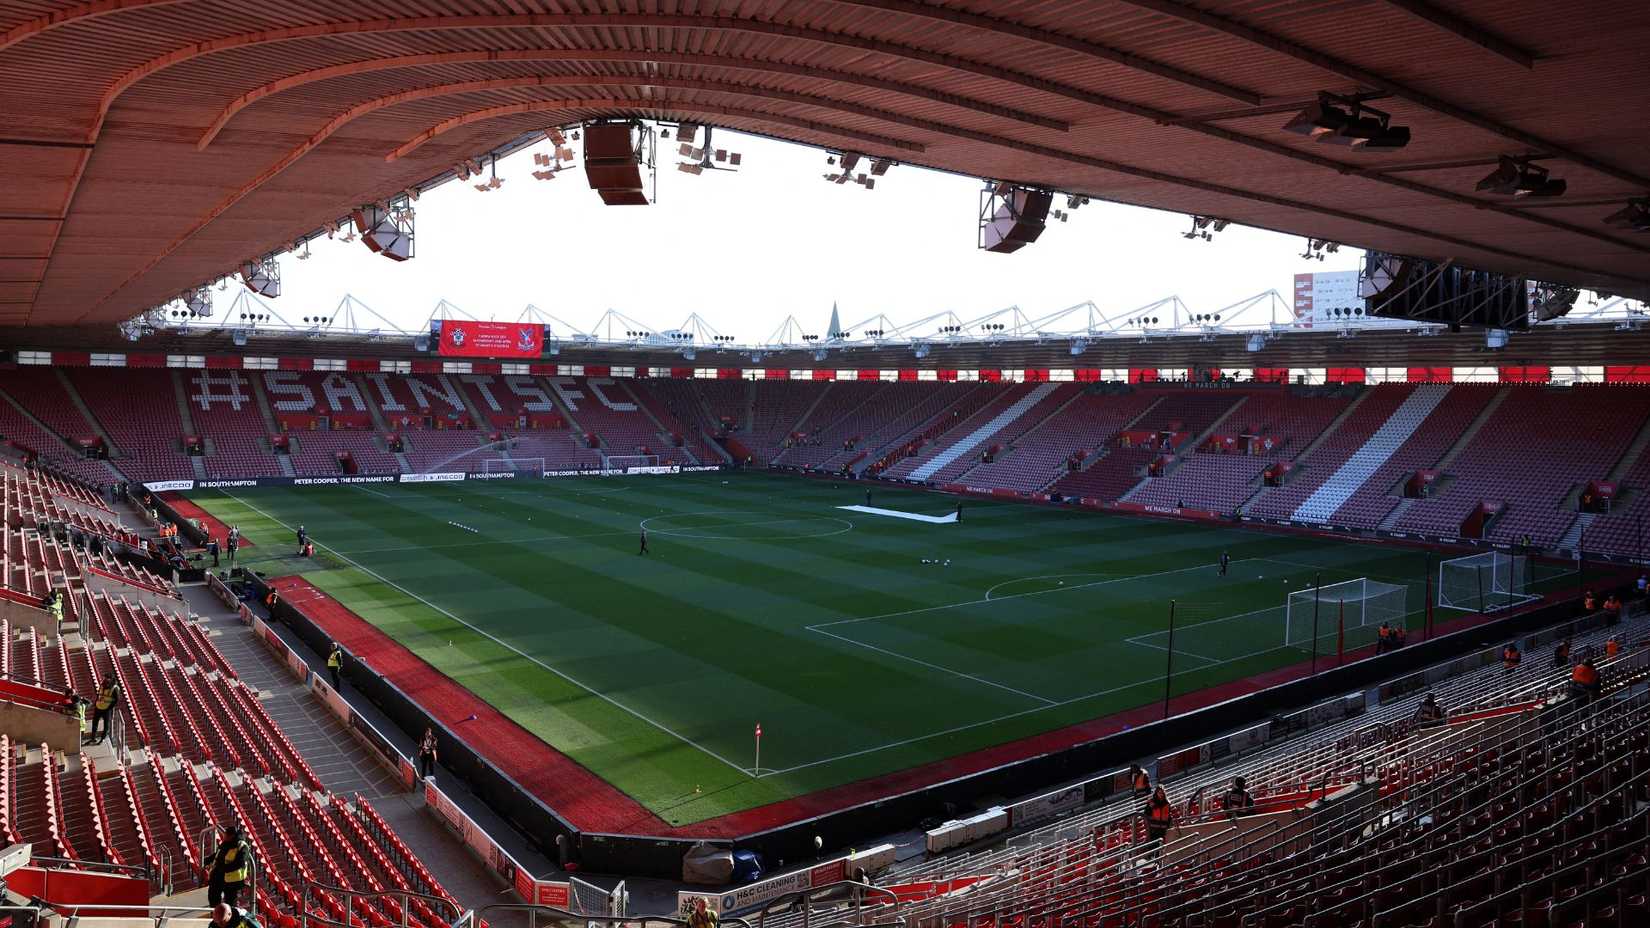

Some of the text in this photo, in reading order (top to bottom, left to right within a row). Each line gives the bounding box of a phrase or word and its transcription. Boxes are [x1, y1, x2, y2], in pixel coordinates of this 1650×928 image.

[208, 480, 257, 488] SOUTHAMPTON
[737, 876, 796, 900] H&C CLEANING
